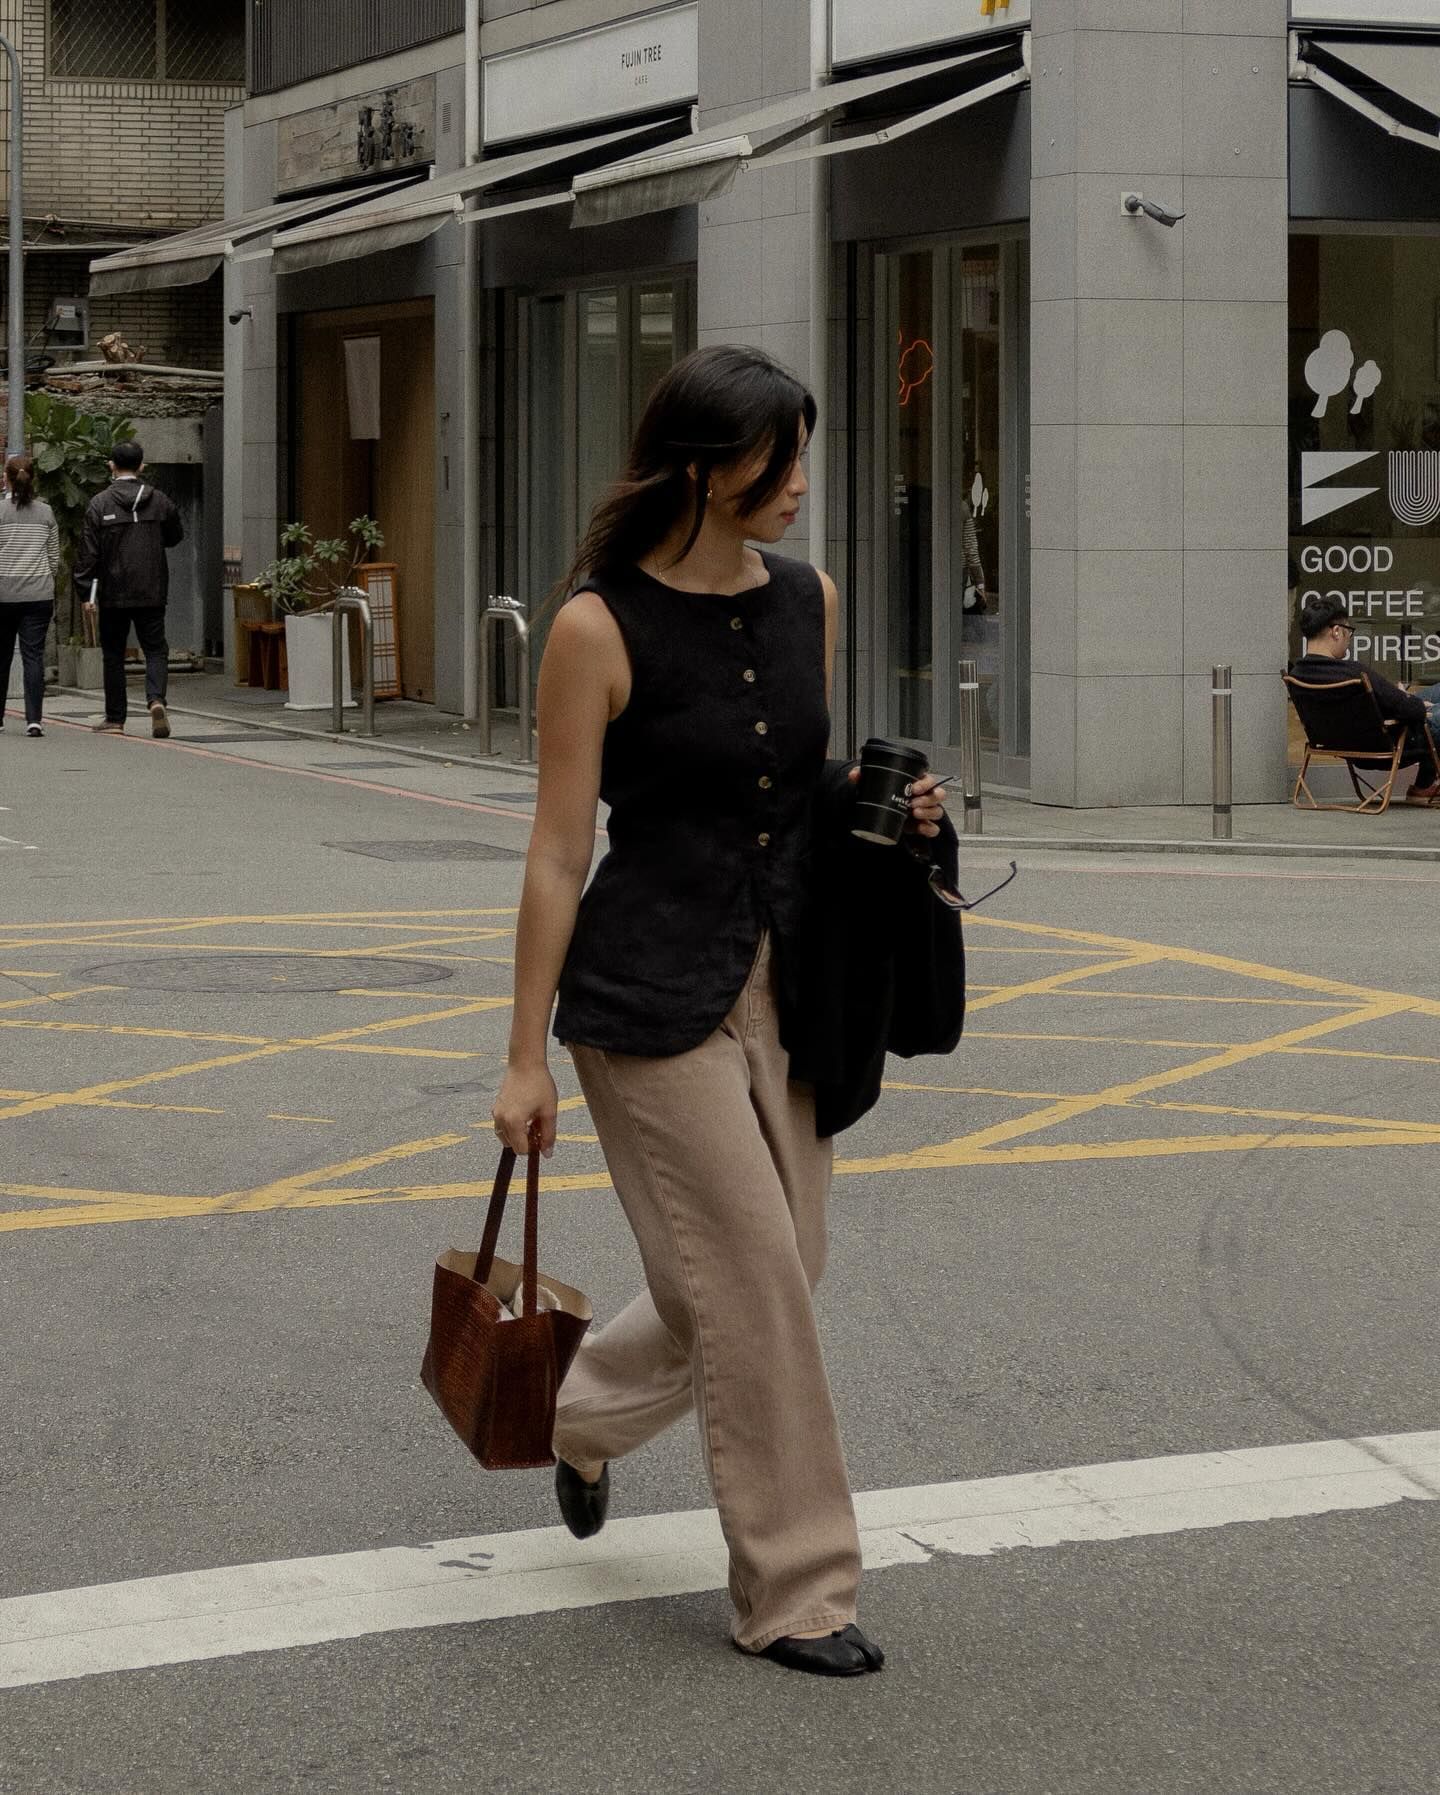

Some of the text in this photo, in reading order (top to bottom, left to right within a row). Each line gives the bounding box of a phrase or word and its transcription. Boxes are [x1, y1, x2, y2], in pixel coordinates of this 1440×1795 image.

[621, 44, 661, 69] FUJIN TREE
[1300, 545, 1394, 573] GOOD
[1302, 635, 1440, 663] IPIRES
